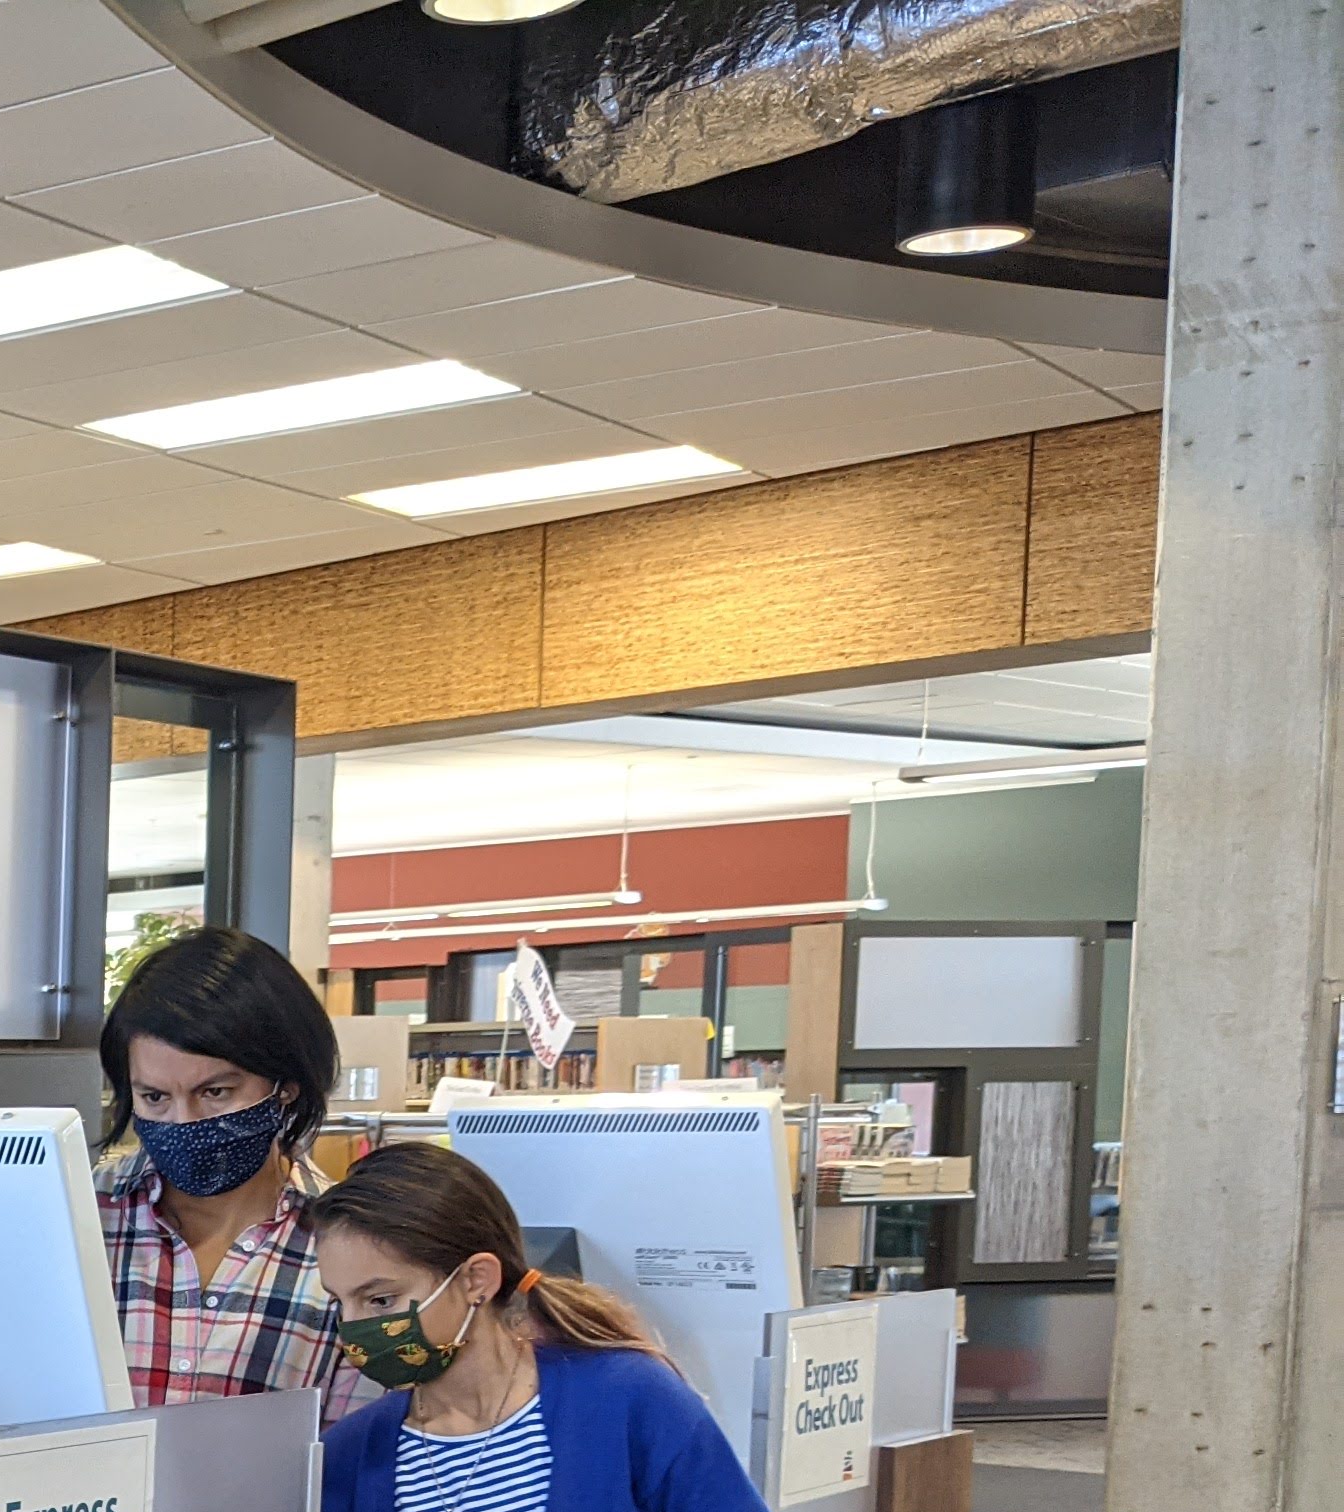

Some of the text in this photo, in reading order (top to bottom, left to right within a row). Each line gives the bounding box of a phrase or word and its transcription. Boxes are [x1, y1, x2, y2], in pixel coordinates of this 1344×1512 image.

[531, 960, 560, 1031] We Need
[805, 1359, 859, 1397] Express
[796, 1393, 864, 1435] Check Out
